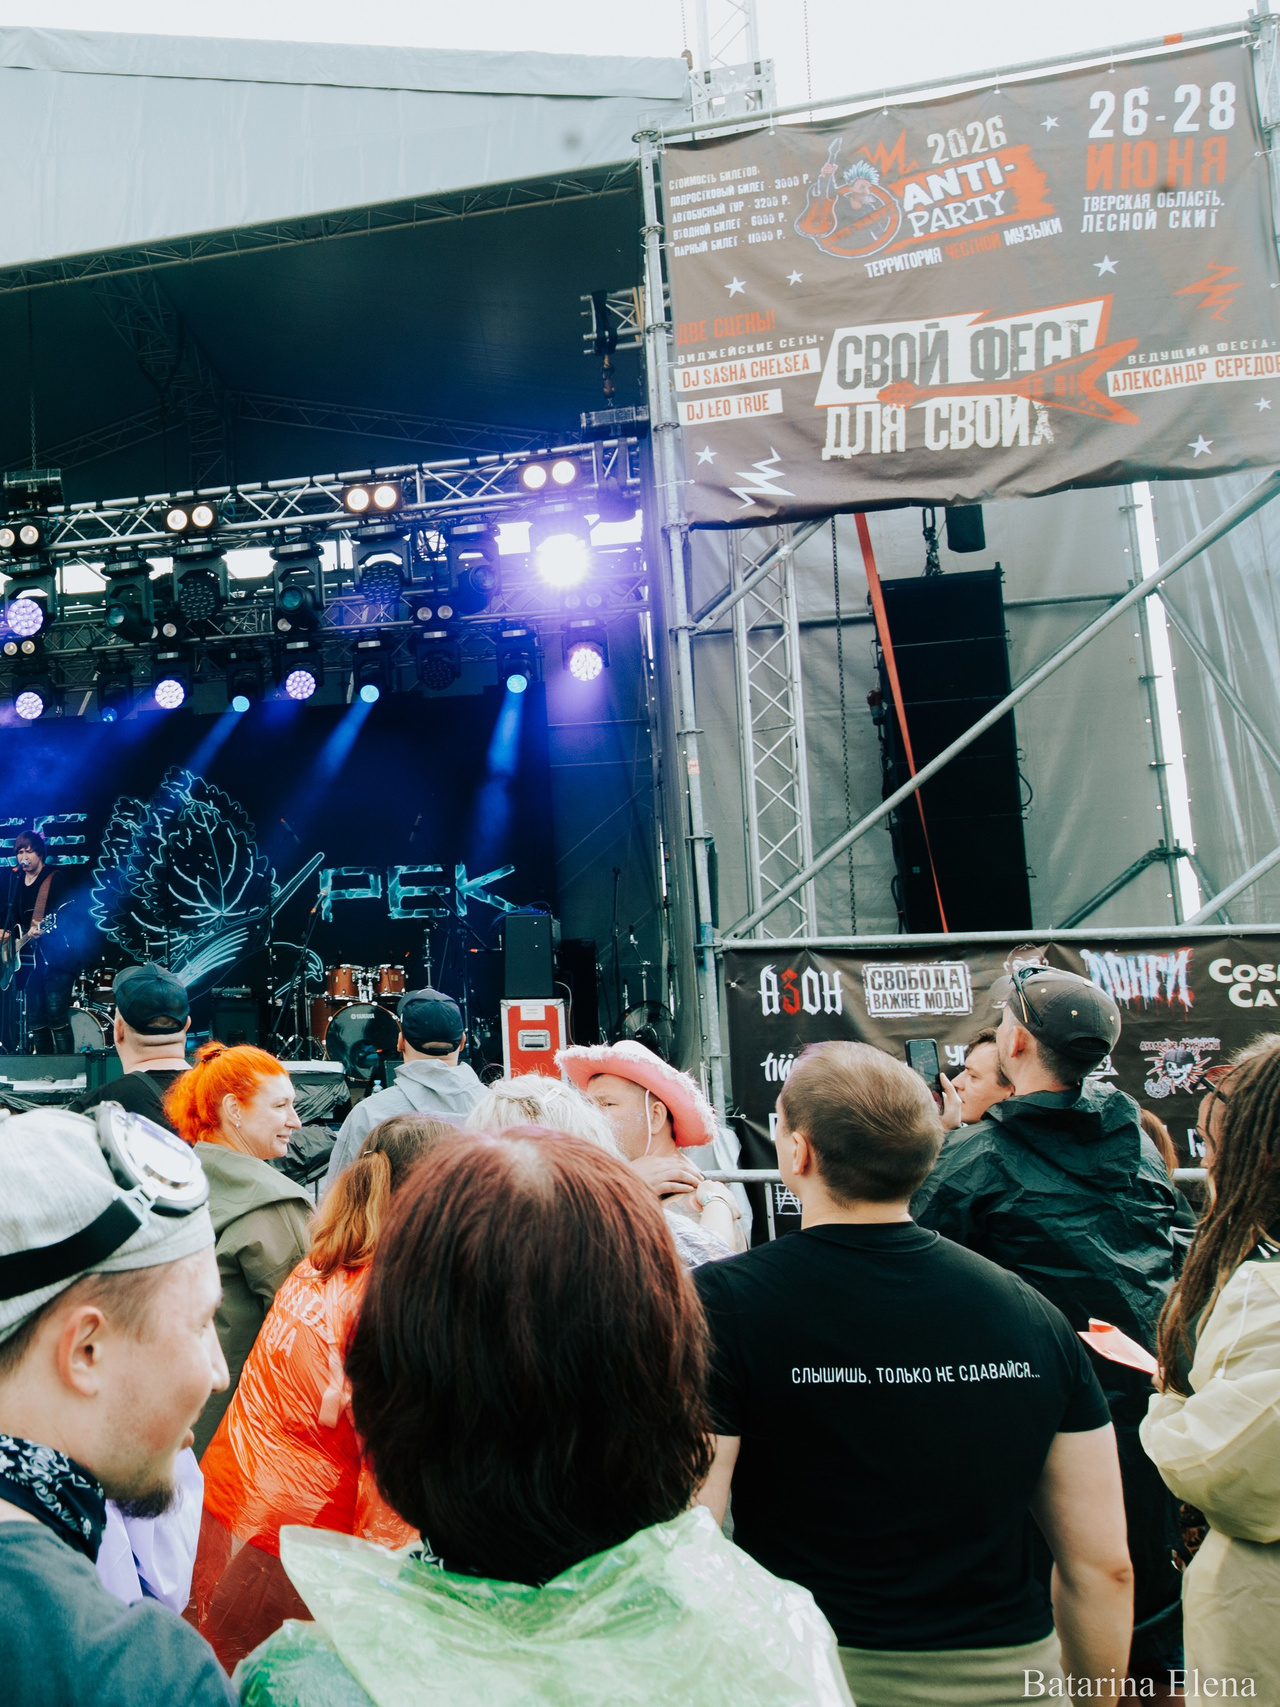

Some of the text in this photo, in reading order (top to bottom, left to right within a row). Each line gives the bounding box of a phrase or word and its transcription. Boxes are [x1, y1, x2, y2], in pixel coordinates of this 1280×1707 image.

[1088, 81, 1236, 139] 26-28
[926, 115, 1007, 165] 2026
[1086, 135, 1228, 191] ИЮНЯ
[669, 173, 716, 191] СТОИМОСТЬ
[670, 187, 735, 207] ПОДРОСТКОВЫЙ
[737, 181, 765, 195] БИЛЕТ
[775, 177, 799, 190] 3000
[903, 157, 1016, 212] ANTI-
[672, 203, 725, 224] АВТОБУСНЫЙ
[729, 201, 744, 213] ТУР
[754, 196, 778, 209] 3200
[907, 190, 1006, 239] PARTY
[1083, 193, 1151, 212] ТВЕРСКАЯ
[673, 221, 710, 240] ВХОДНОЙ
[714, 218, 741, 232] БИЛЕТ
[751, 214, 775, 226] 6000
[1080, 208, 1219, 234] ЛЕСНОЙ СКИТ
[674, 239, 708, 257] ПАРНЫЙ
[711, 236, 738, 250] БИЛЕТ
[748, 231, 773, 244] 11000
[864, 217, 1063, 279] ТЕРРИТОРИЯ ЧЕСТНОЙ МУЗЫКИ
[677, 309, 777, 346] ДВЕ СЦЕНЫ!
[677, 341, 773, 365] ДИДЖЕЙСКИЕ
[837, 319, 1089, 391] СВОЙ ФЕСТ
[1128, 344, 1209, 365] ВЕДУЩИЙ
[683, 353, 810, 389] DJ SASHA CHELSEA
[1112, 362, 1206, 393] АЛЕКСАНДР
[686, 393, 769, 421] DJ LEO TRUE
[821, 404, 907, 461] ДЛЯ
[871, 968, 962, 991] СВОБОДА
[873, 992, 964, 1010] ВАЖНЕЕ МОДЫ
[791, 1360, 1040, 1385] СЛЫШИШЬ, ТОЛЬКО НЕ СДАВАЙСЯ...
